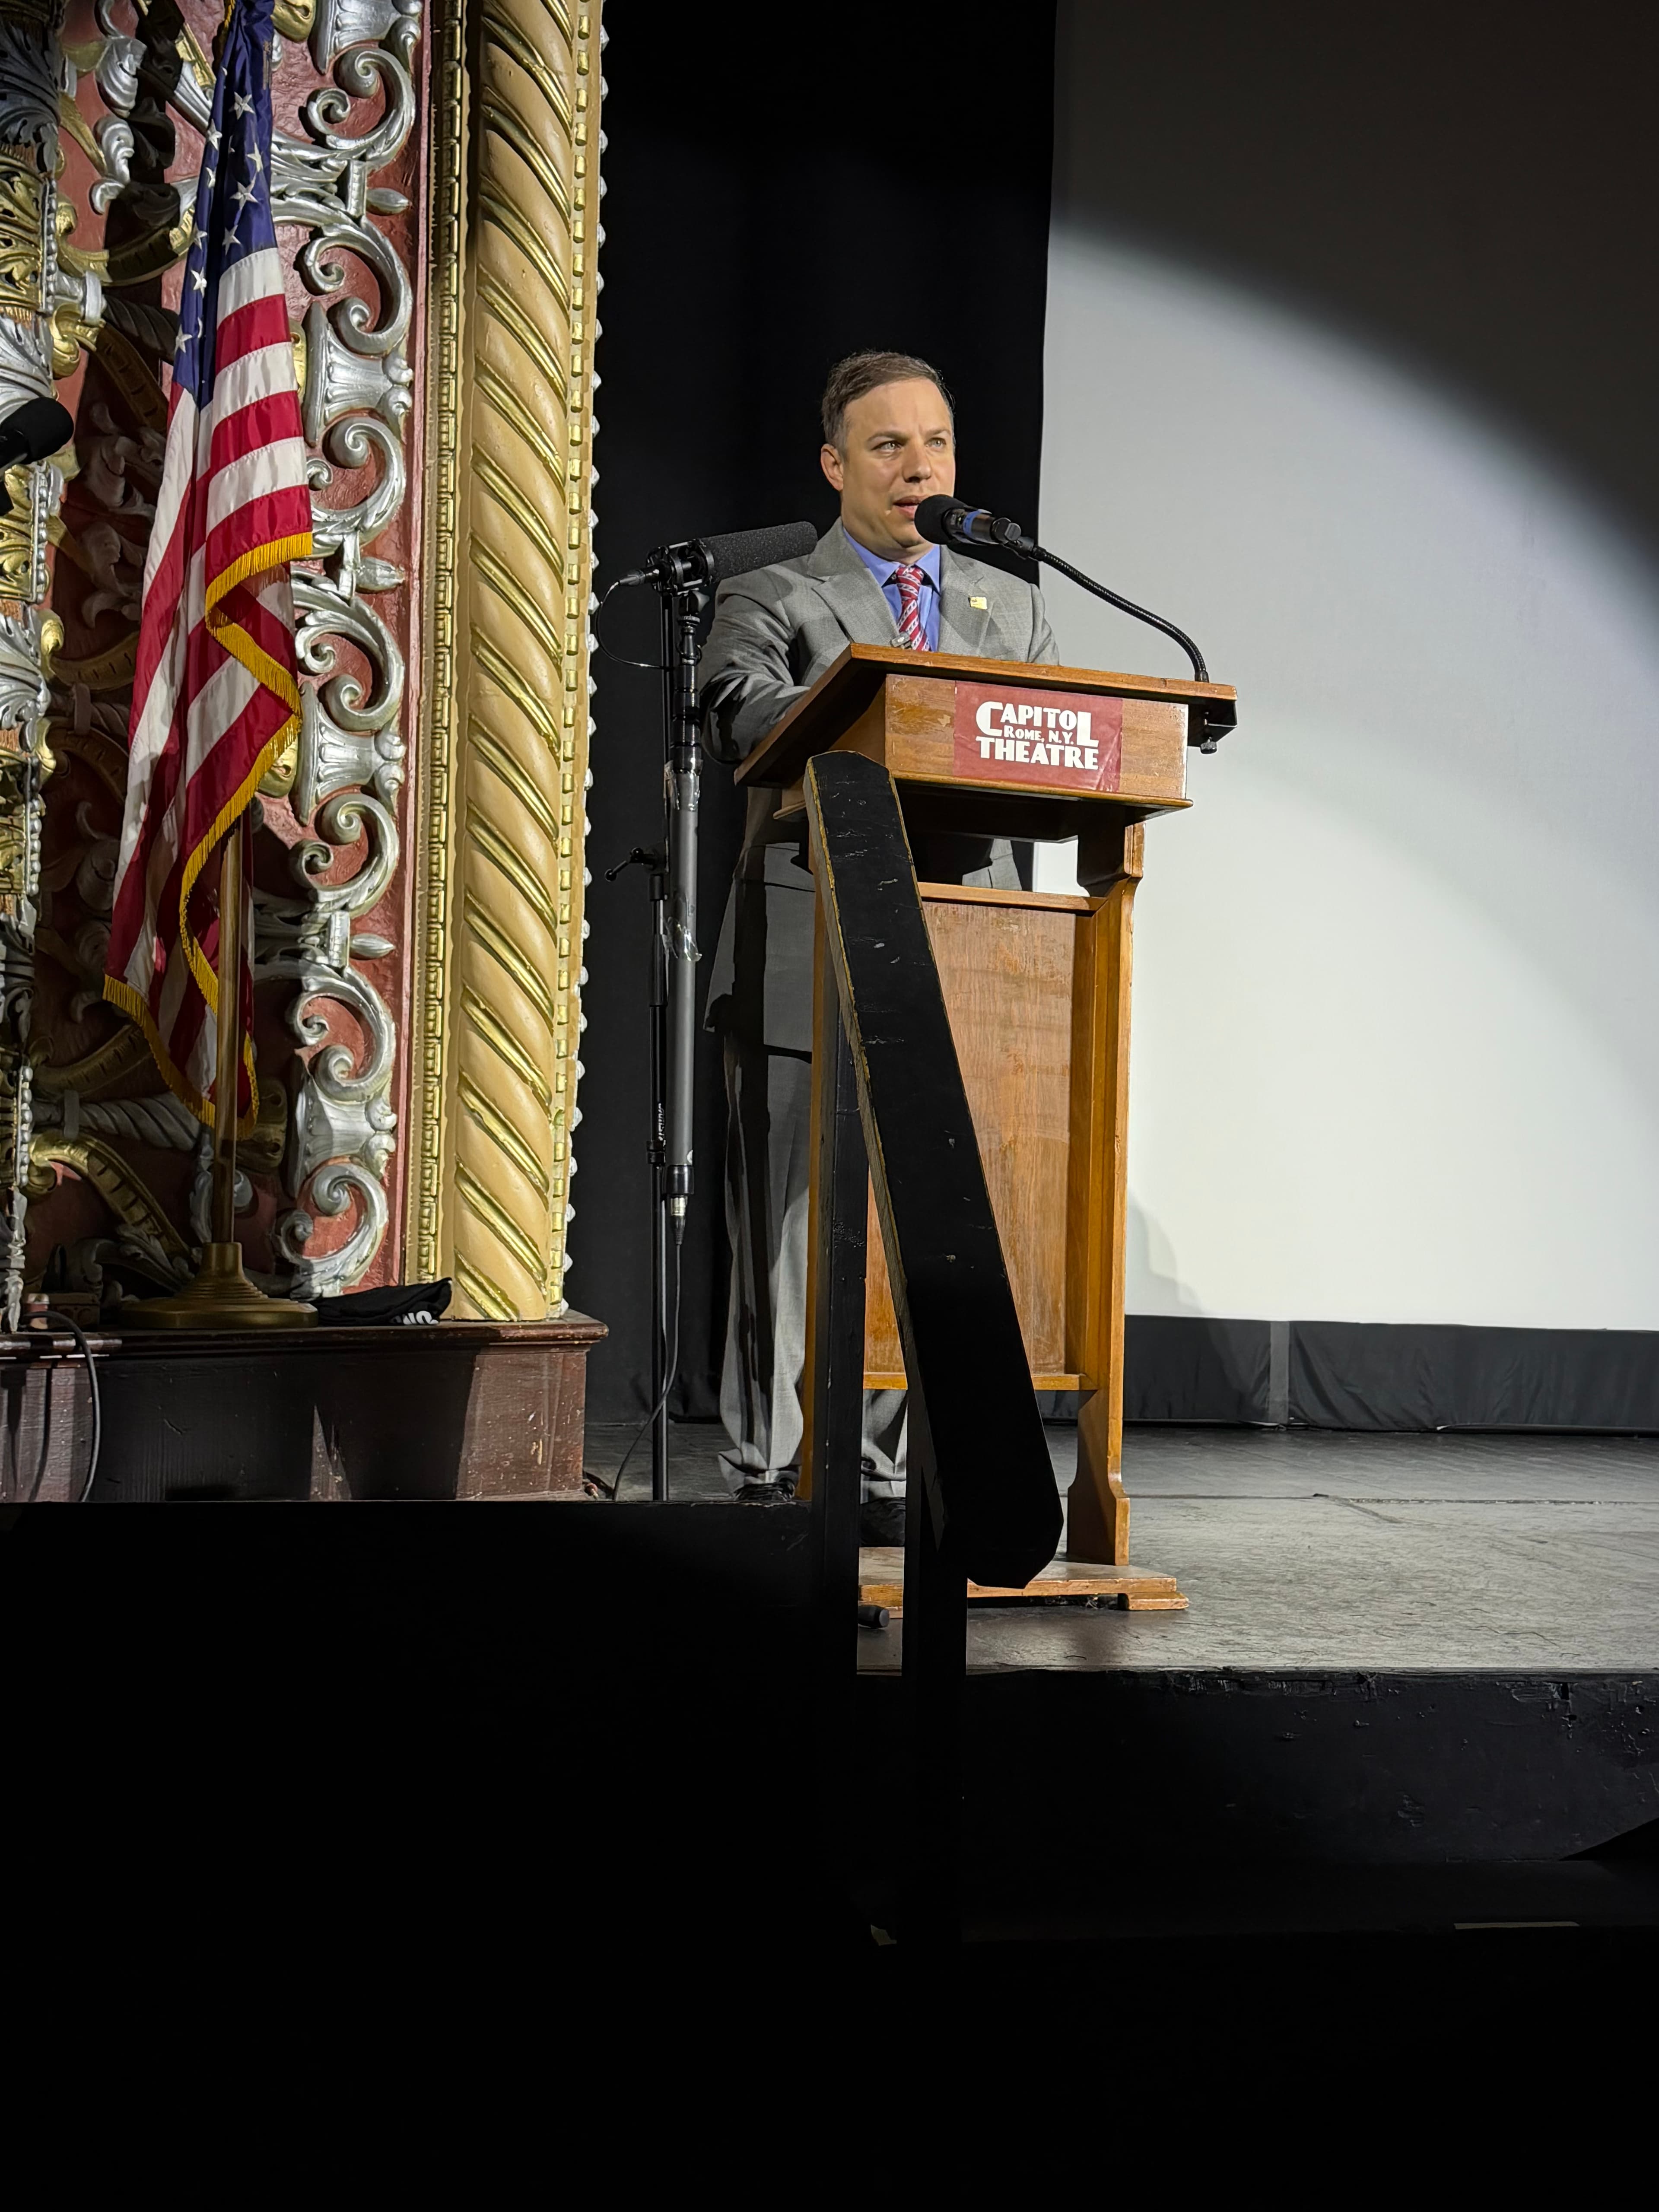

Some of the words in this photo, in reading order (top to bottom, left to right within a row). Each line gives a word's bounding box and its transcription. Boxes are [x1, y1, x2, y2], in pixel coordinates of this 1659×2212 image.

[976, 701, 1099, 747] CAPITOL
[1004, 725, 1045, 743] ROME,
[1049, 731, 1074, 745] N.Y.
[976, 736, 1099, 770] THEATRE
